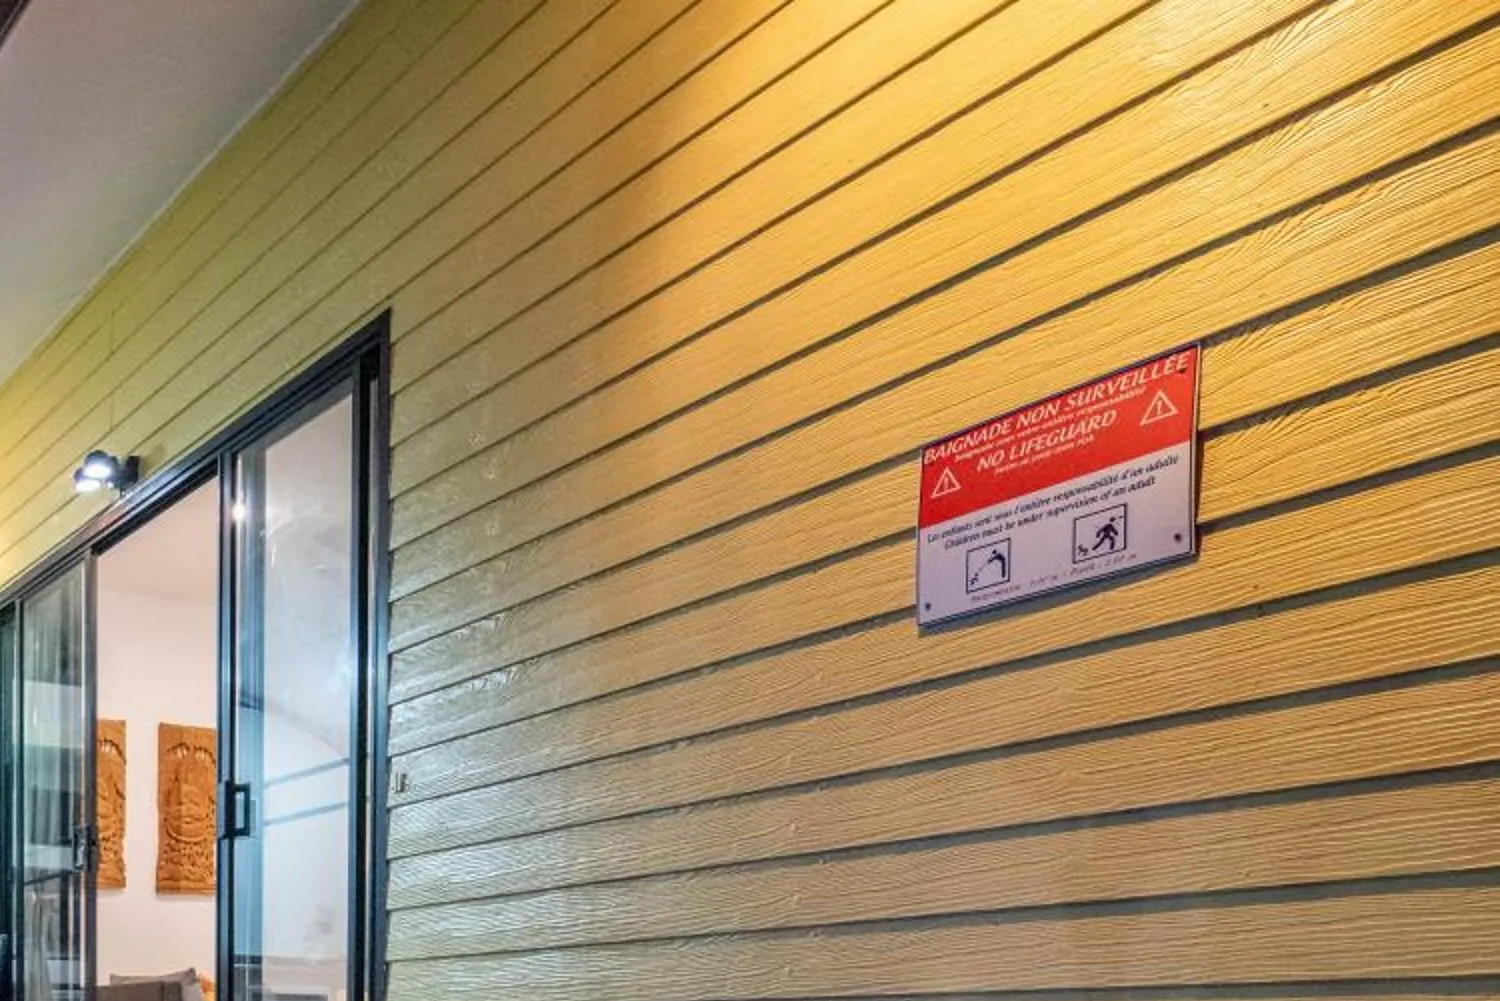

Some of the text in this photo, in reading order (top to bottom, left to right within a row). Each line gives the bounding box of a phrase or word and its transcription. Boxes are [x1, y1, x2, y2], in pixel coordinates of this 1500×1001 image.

[923, 416, 1013, 465] BAIGNADE
[1016, 399, 1061, 431] NON
[977, 449, 1006, 473] NO
[1009, 409, 1117, 461] LIFEGUARD
